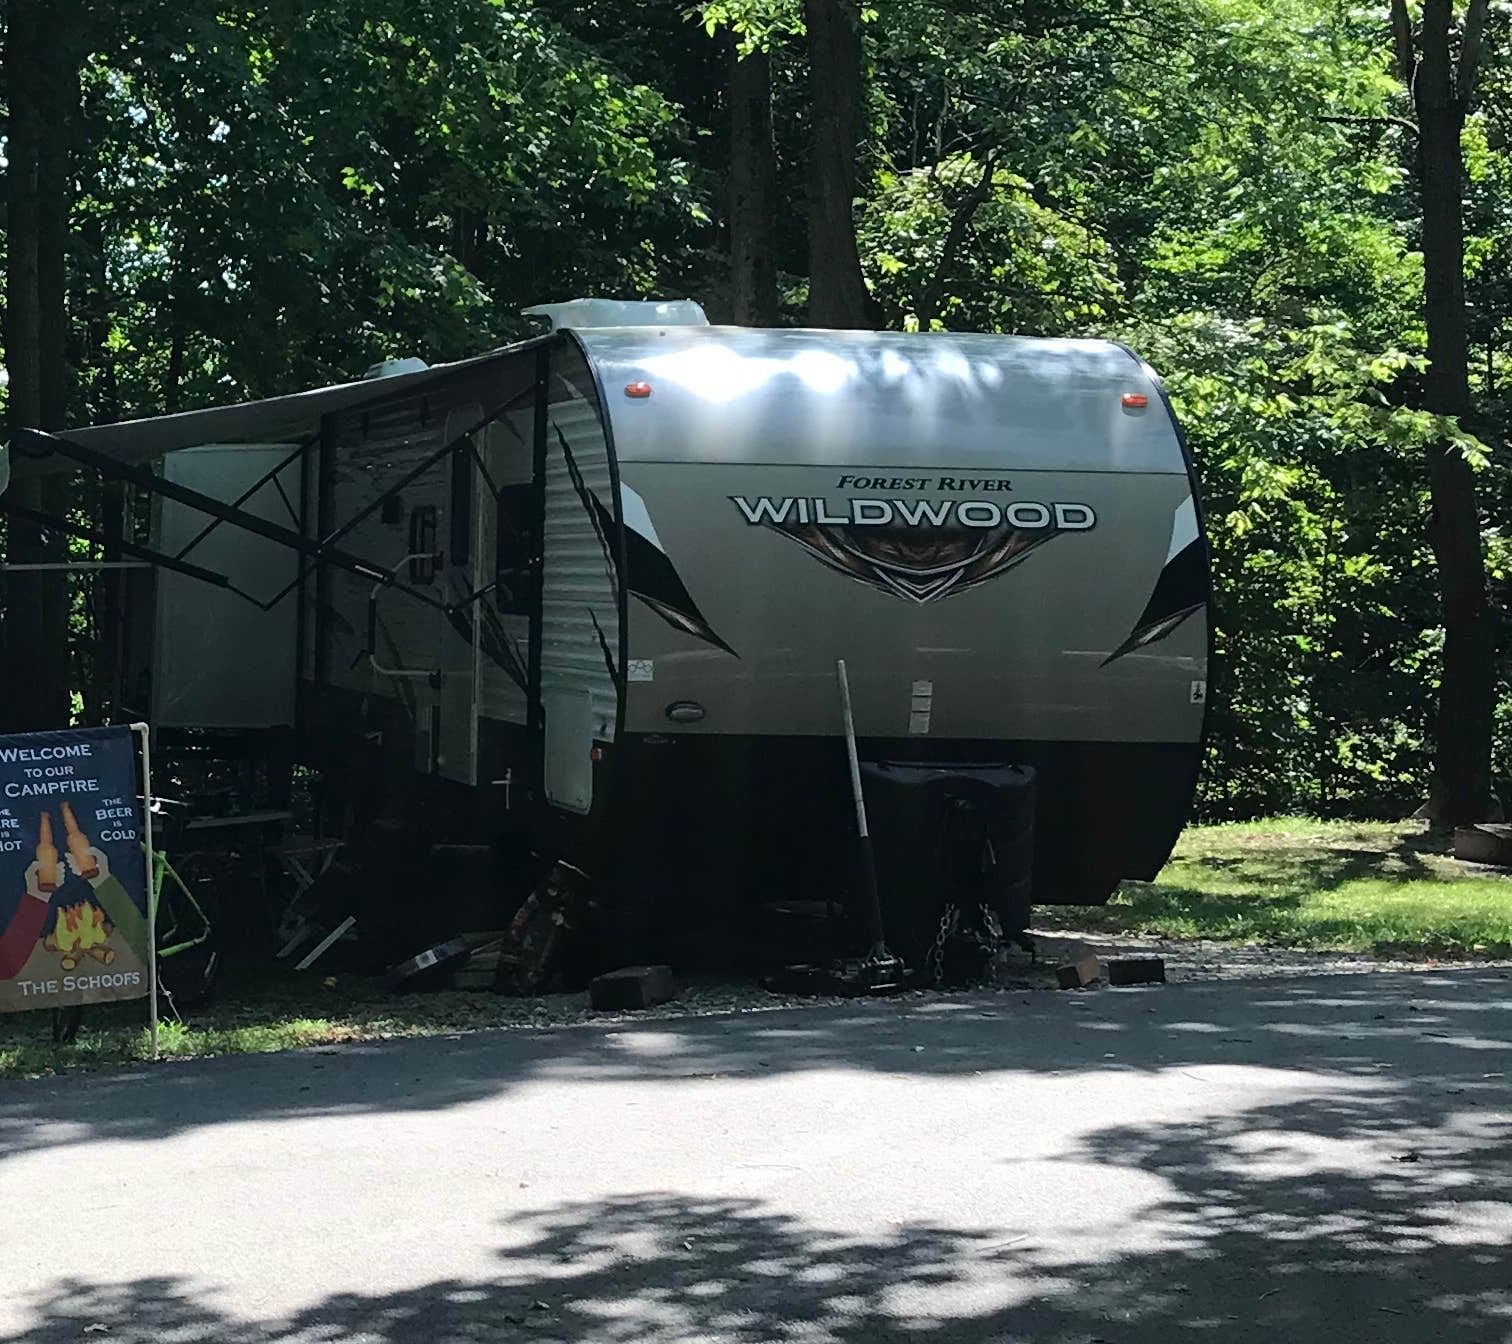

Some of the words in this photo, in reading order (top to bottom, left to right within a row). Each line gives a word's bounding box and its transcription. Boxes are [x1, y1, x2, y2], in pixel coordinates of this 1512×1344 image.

[836, 474, 933, 492] FOREST
[937, 476, 1014, 493] RIVER
[728, 494, 1099, 532] WILDWOOD
[24, 767, 43, 778] TO
[45, 765, 75, 777] OUR
[4, 779, 100, 798] CAMPFIRE
[102, 797, 123, 806] THE
[95, 807, 133, 820] BEER
[100, 829, 136, 842] COLD
[18, 980, 59, 996] THE
[63, 972, 141, 992] SCHOOFS
